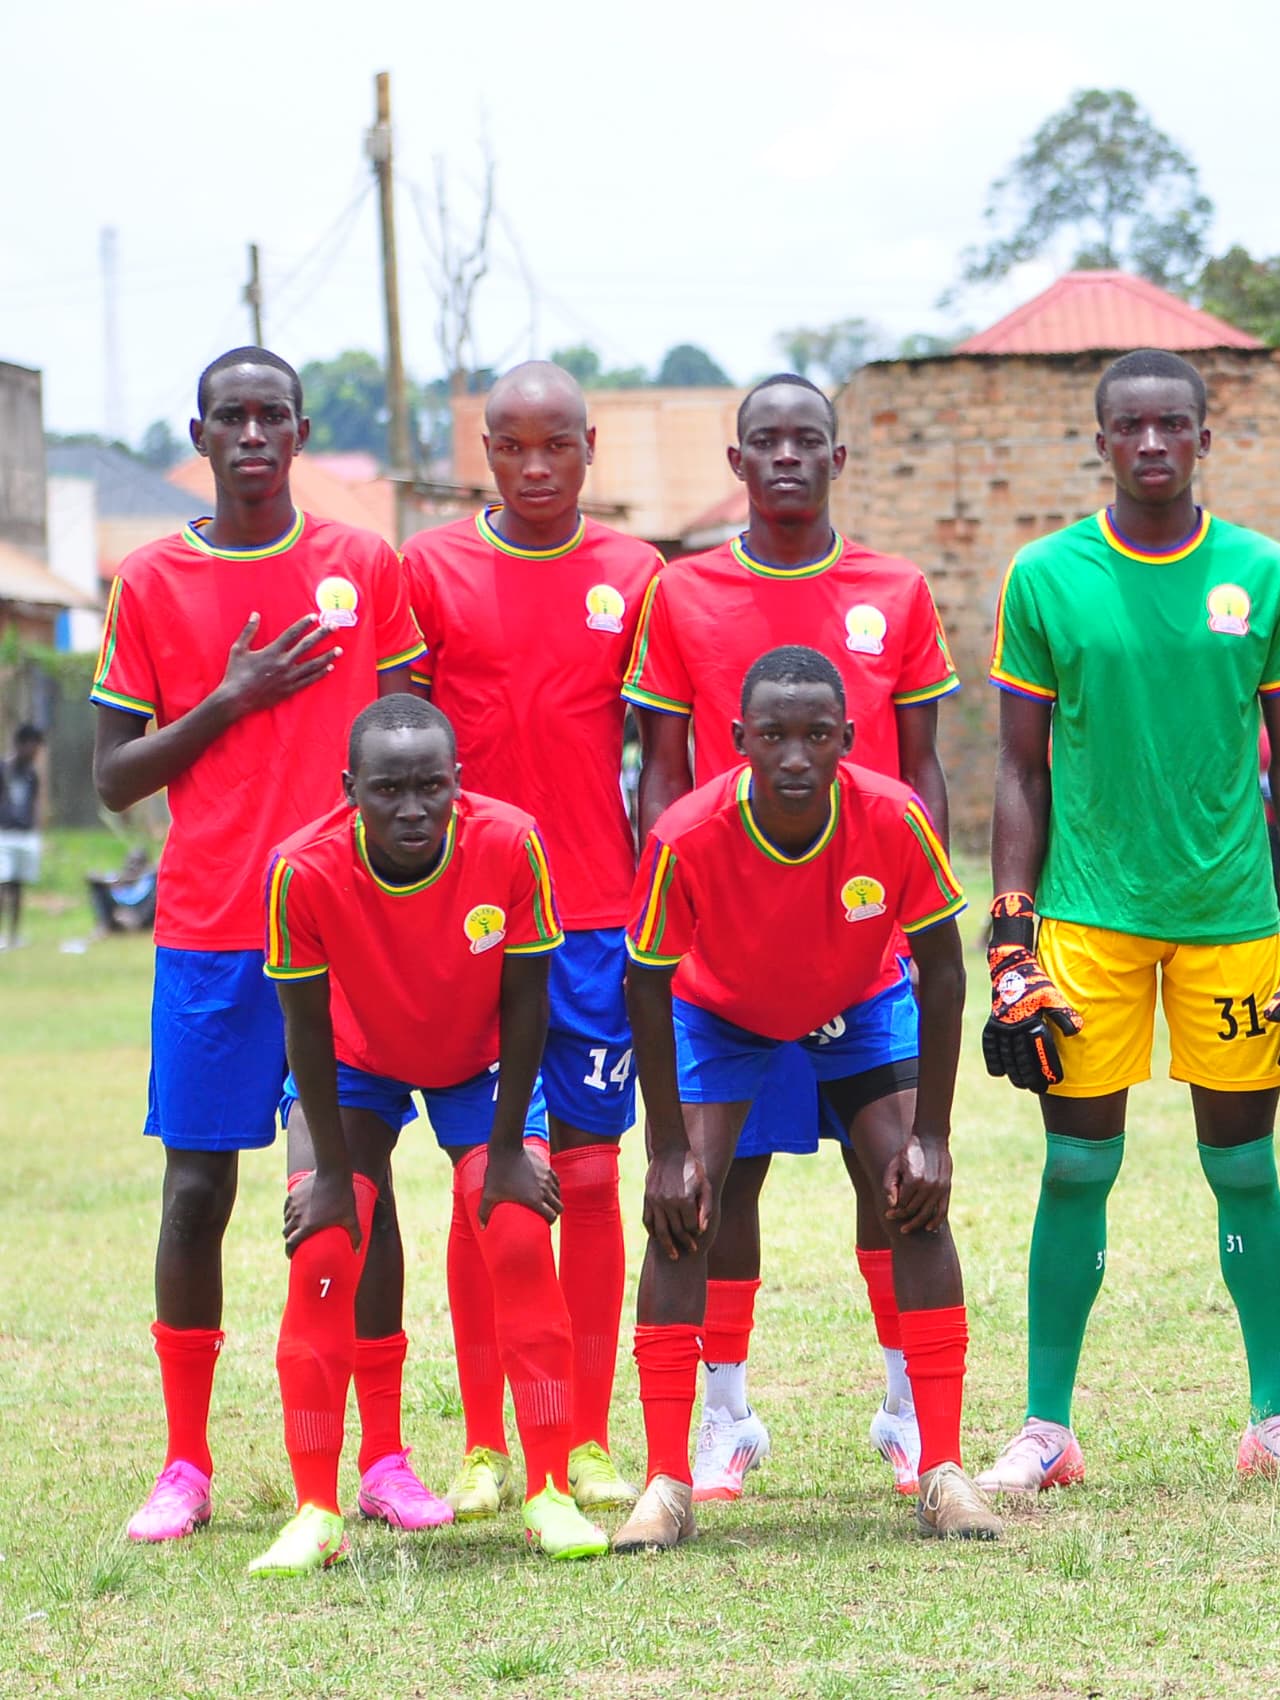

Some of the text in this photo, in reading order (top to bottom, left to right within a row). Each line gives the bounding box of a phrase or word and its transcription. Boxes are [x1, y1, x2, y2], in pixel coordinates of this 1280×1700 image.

[1214, 992, 1266, 1041] 31
[583, 1048, 633, 1092] 14
[1226, 1234, 1244, 1254] 31
[320, 1278, 331, 1298] 7
